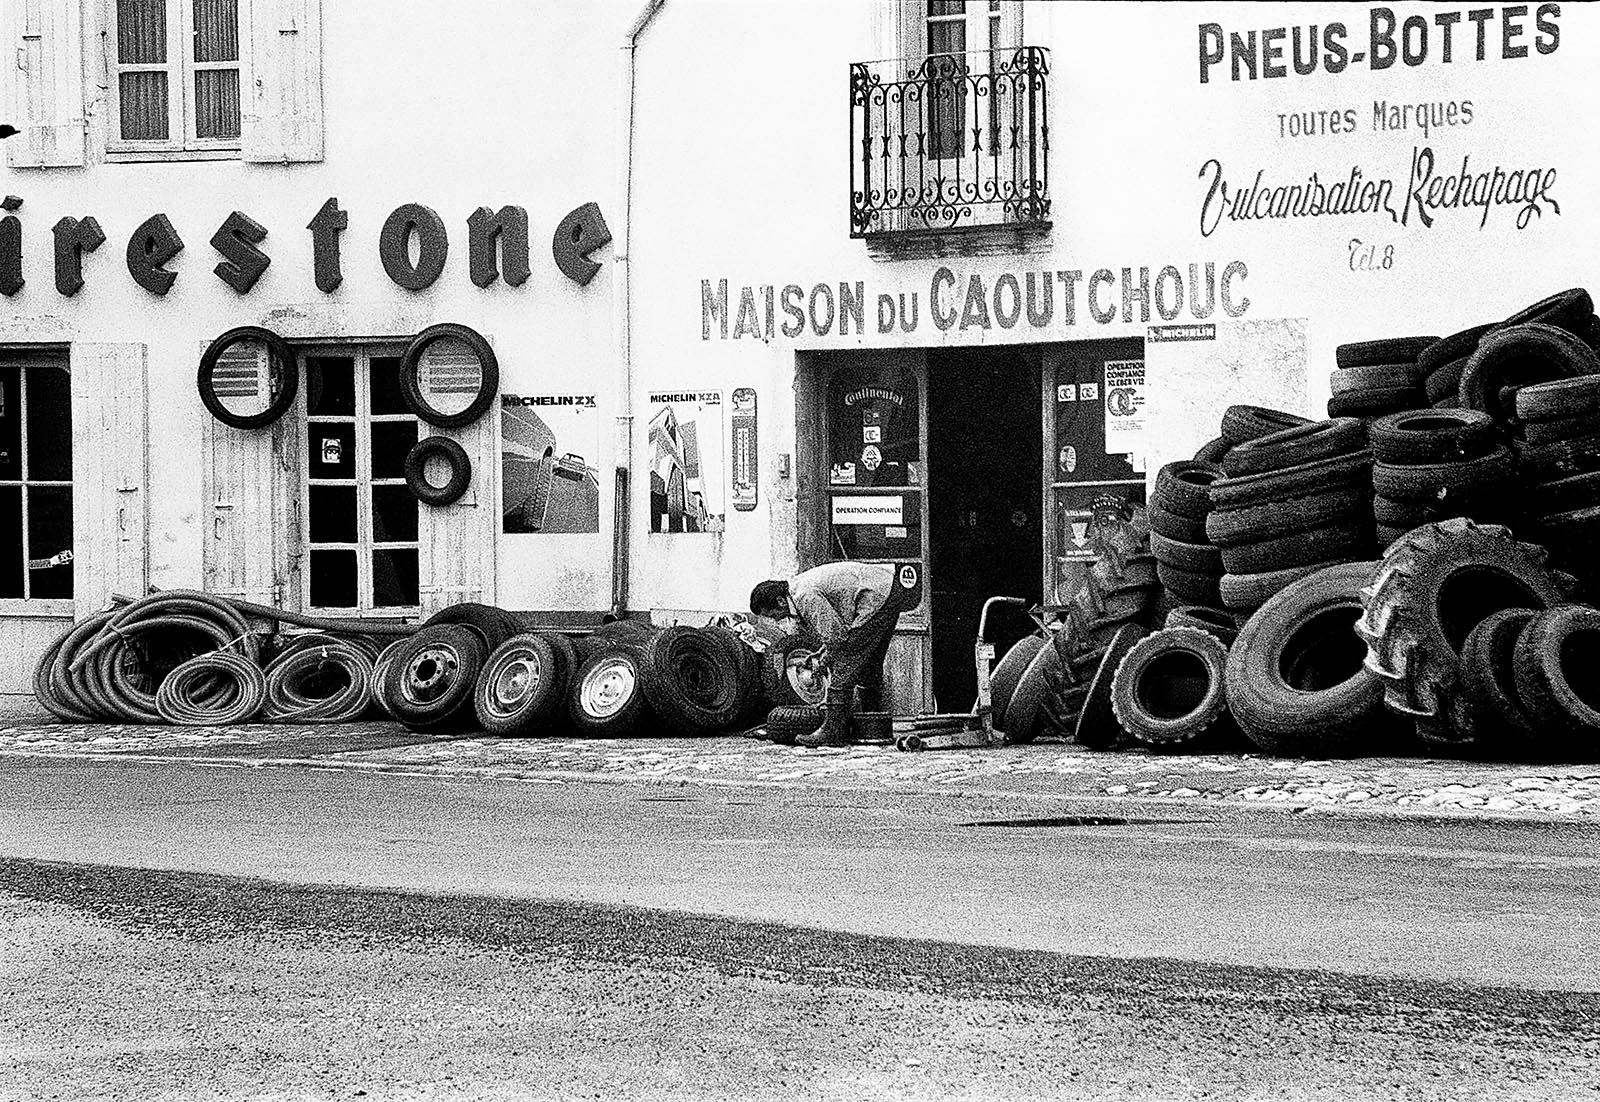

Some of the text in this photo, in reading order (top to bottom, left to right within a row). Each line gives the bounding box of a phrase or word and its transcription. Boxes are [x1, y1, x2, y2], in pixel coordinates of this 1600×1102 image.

[1199, 3, 1561, 84] PNEUS-BOTTES
[1373, 100, 1475, 139] Marques
[1199, 146, 1561, 237] Vulcanisation Rechapage
[701, 260, 1251, 341] MAISON DU CAOUTCHOUC
[650, 393, 697, 404] MICHELIN
